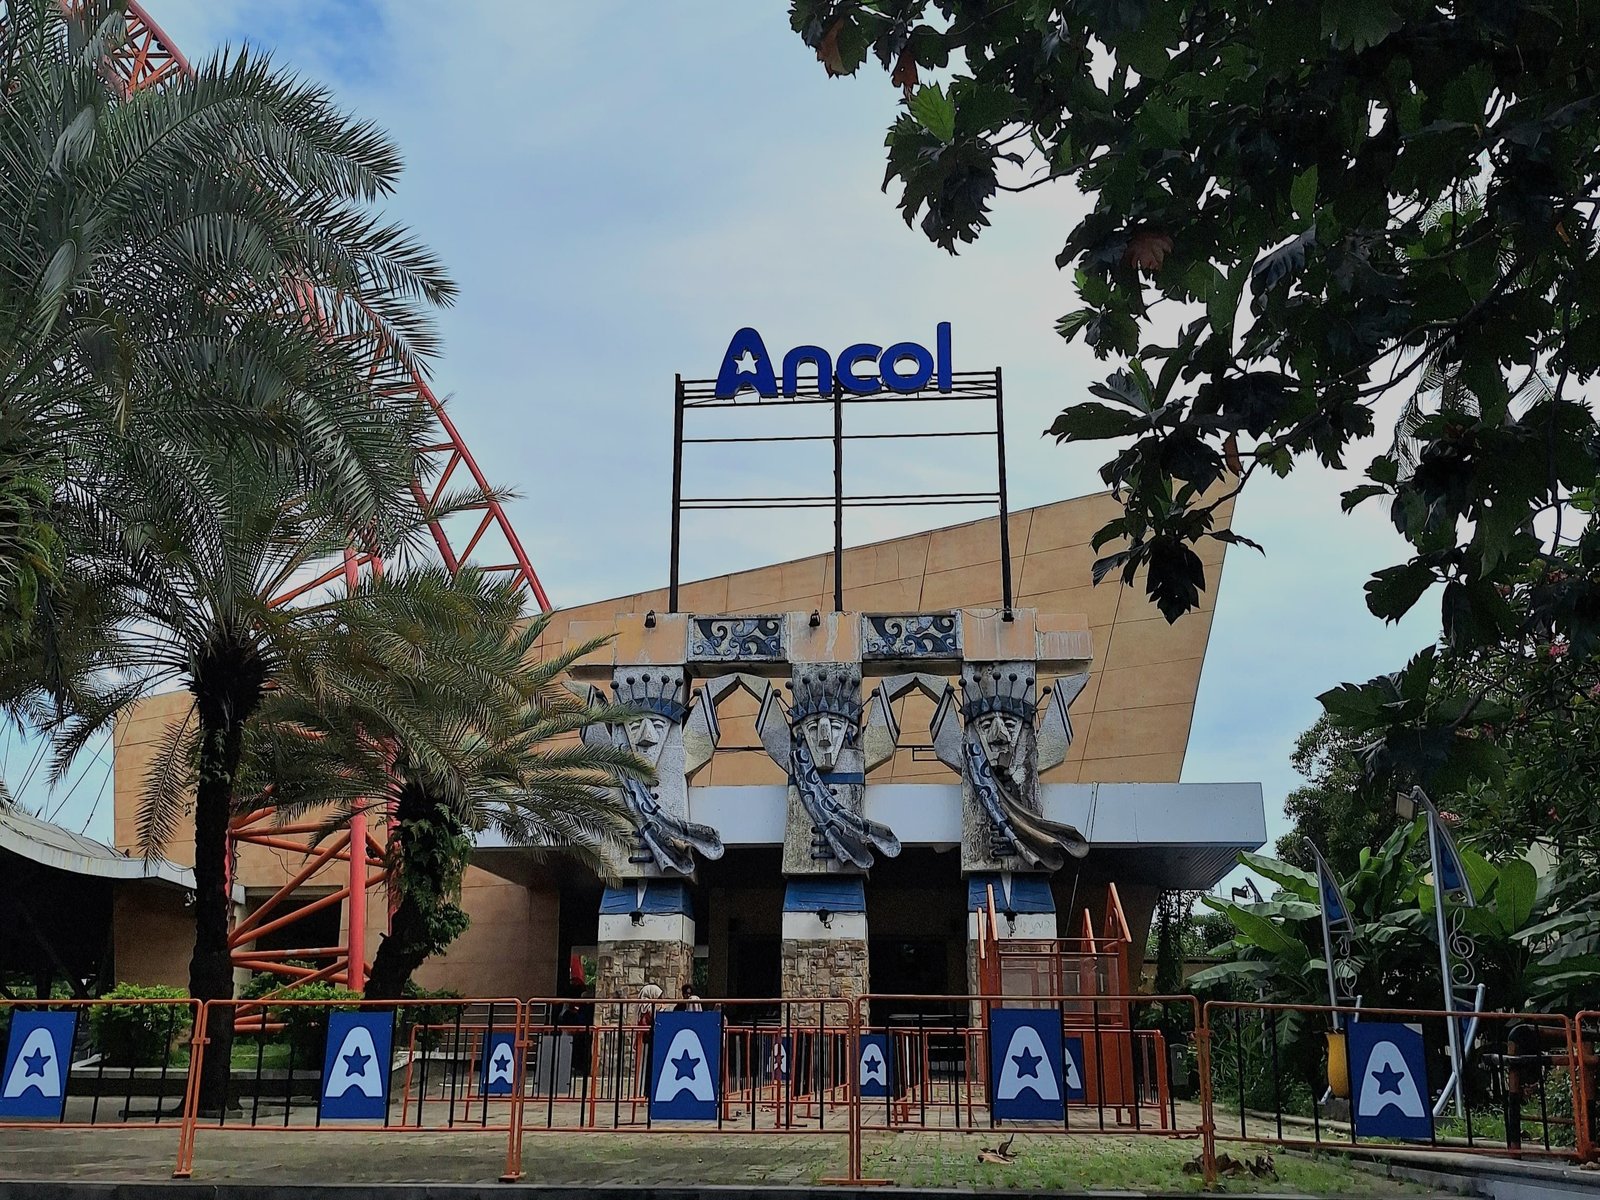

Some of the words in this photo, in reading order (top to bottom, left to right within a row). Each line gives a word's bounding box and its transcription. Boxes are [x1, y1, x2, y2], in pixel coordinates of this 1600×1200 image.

[715, 321, 952, 399] Ancol
[3, 1027, 61, 1098] A
[324, 1026, 383, 1098] A
[655, 1028, 715, 1102] A
[997, 1025, 1060, 1100] A
[1358, 1041, 1426, 1117] A
